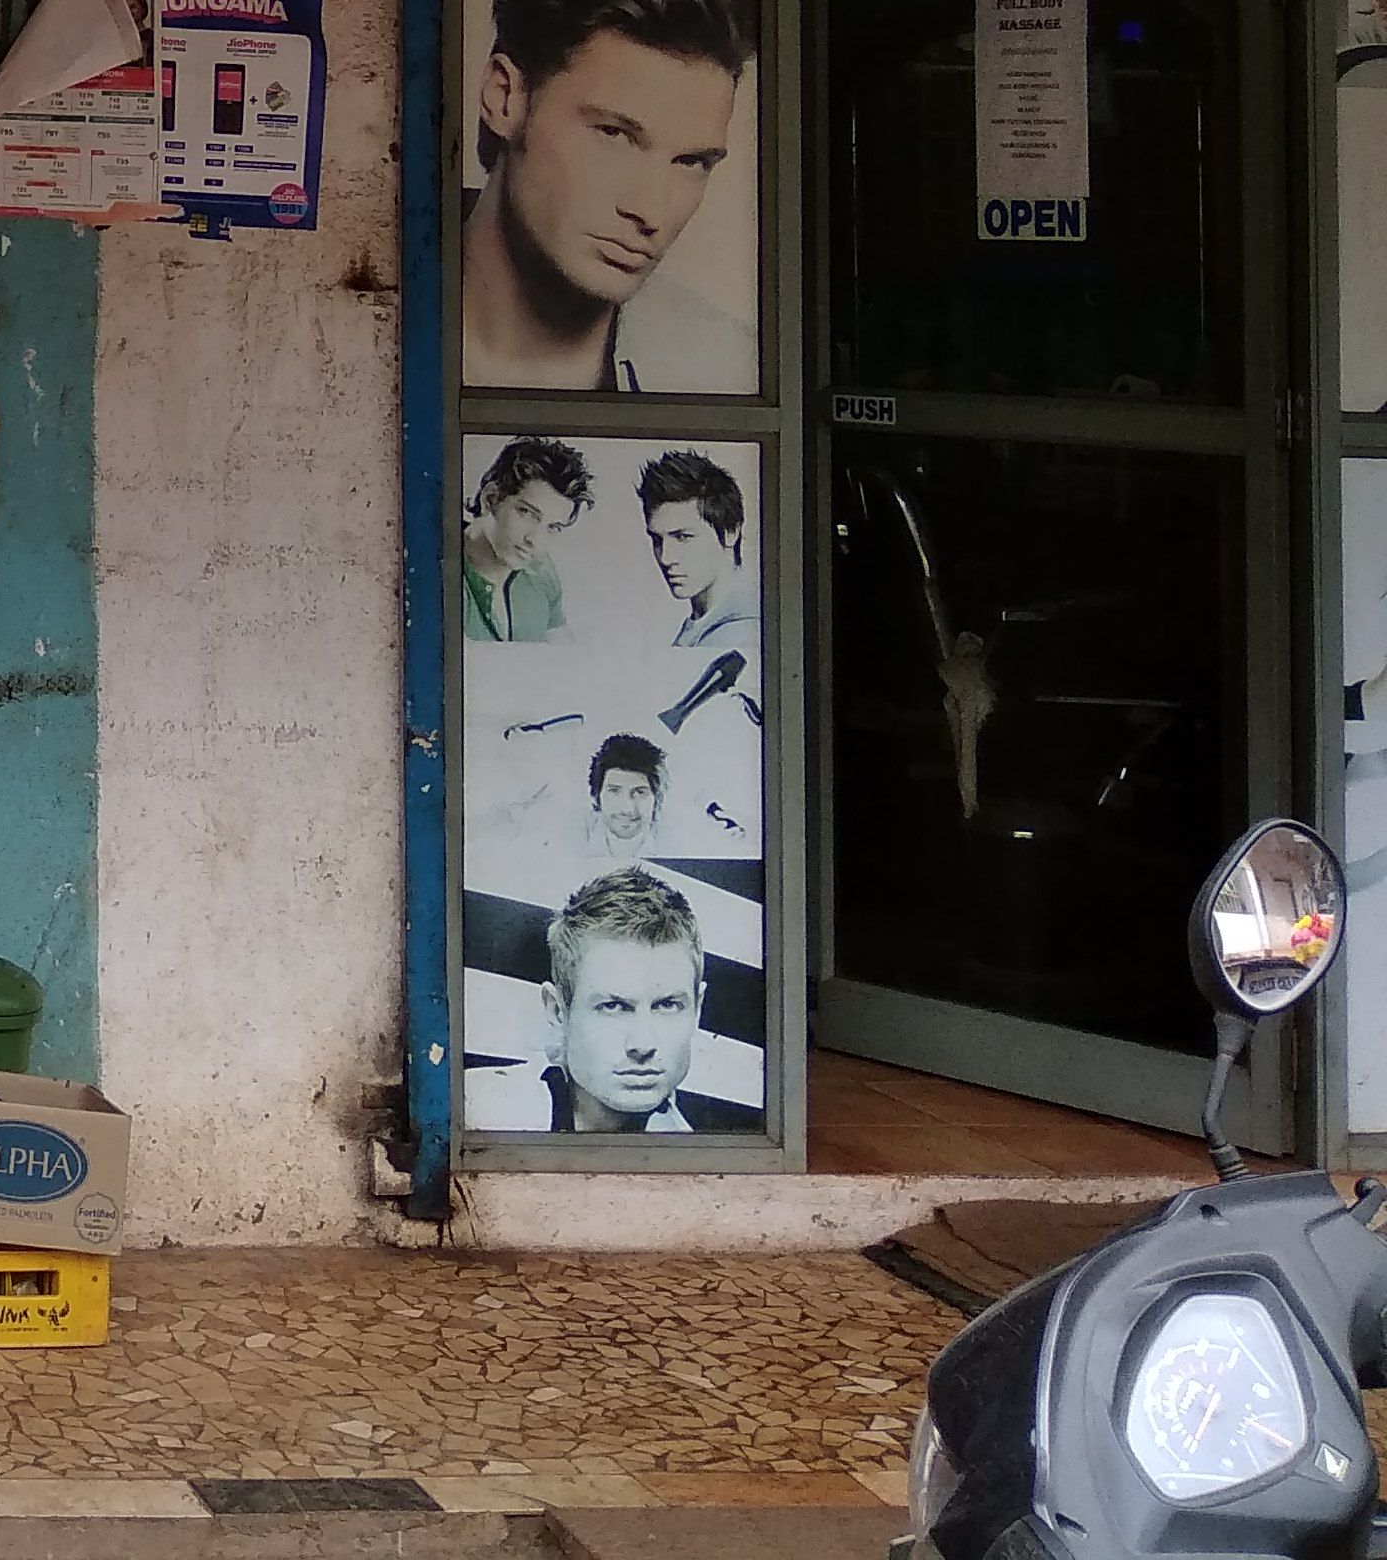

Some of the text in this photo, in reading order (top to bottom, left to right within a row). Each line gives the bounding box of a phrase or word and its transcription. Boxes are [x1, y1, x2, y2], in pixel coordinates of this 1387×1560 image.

[998, 18, 1062, 31] MASSAGE
[226, 38, 277, 50] JioPhone
[983, 199, 1081, 238] OPEN
[834, 396, 895, 423] PUSH
[78, 1205, 116, 1219] Fortified
